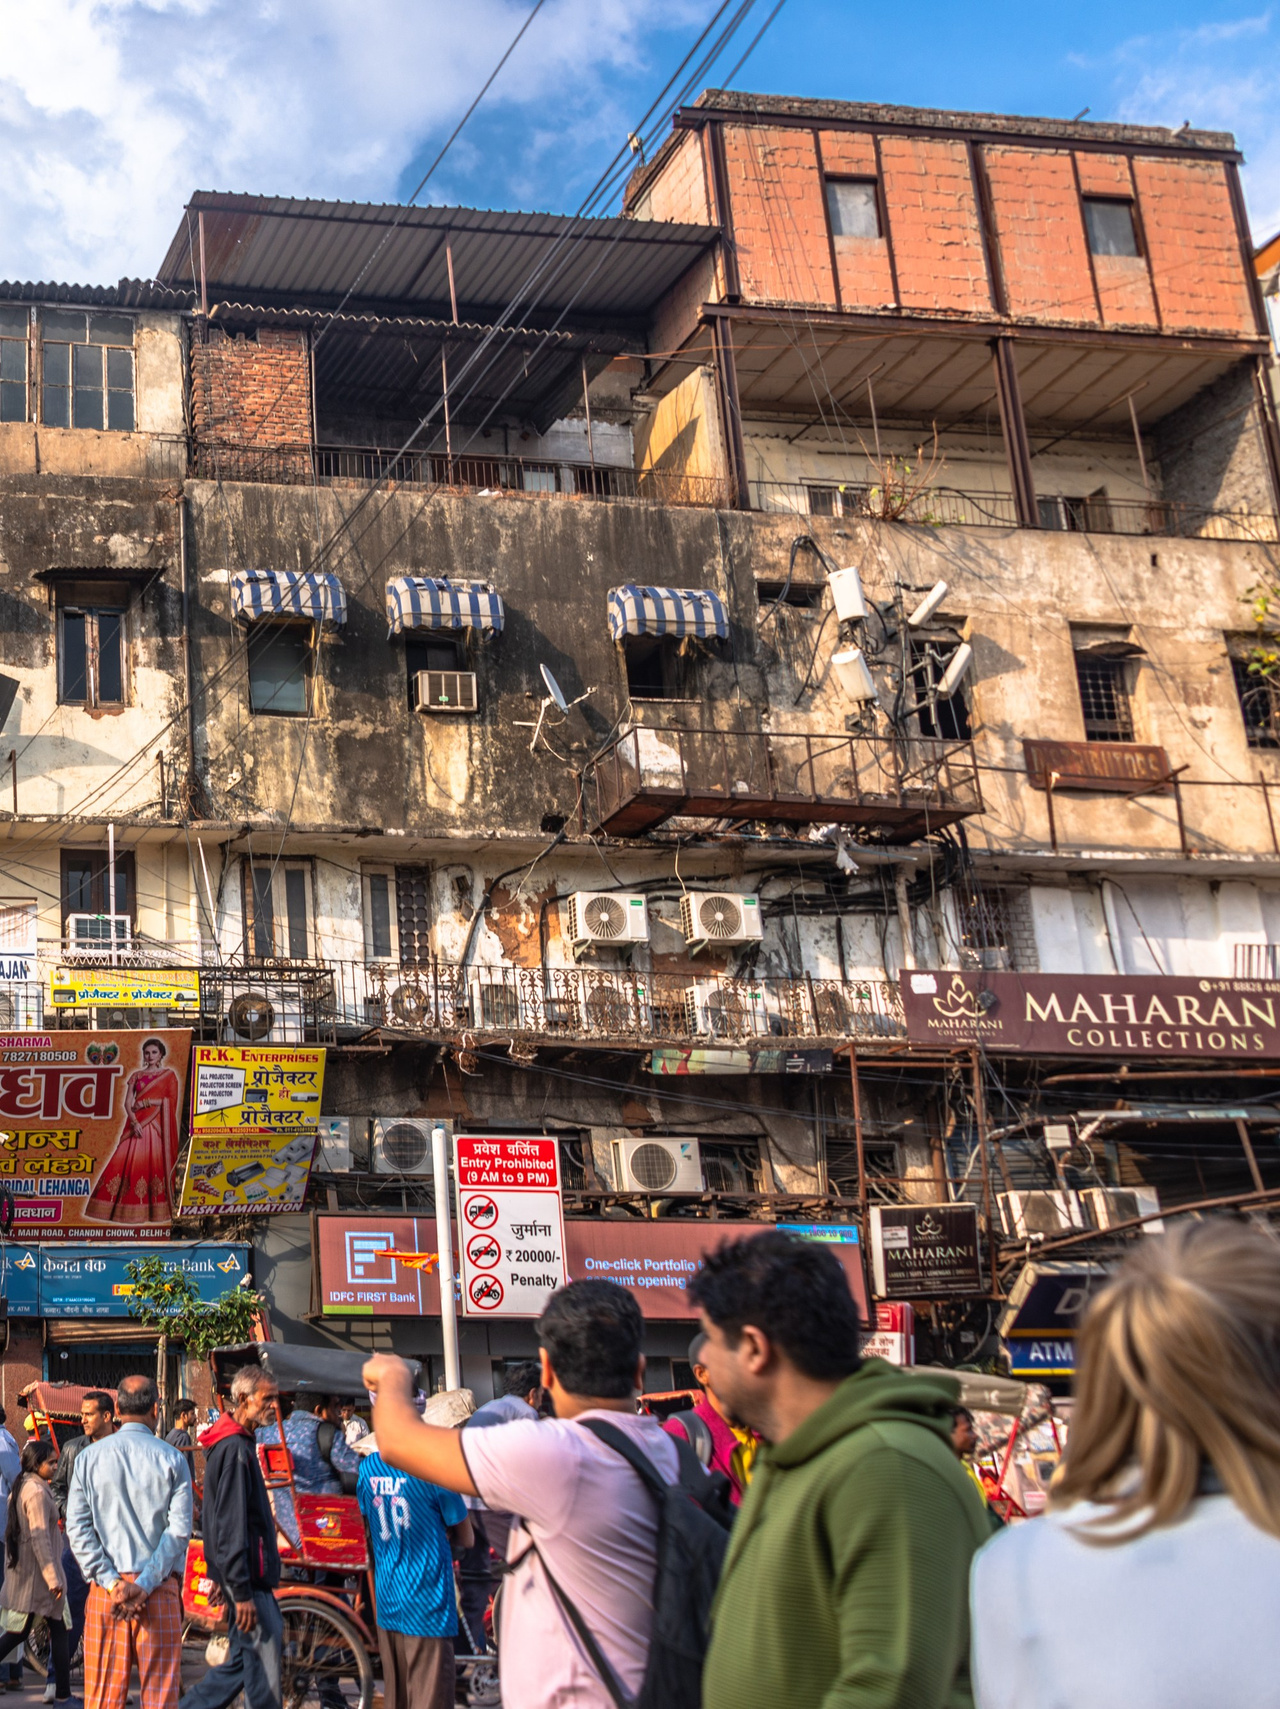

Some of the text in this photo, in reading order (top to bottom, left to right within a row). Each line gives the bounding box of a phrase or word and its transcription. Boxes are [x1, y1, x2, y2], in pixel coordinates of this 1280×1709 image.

[927, 1019, 1003, 1030] MAHARANI
[1068, 1029, 1265, 1051] COLLECTIONS
[3, 1051, 77, 1062] 7827180508
[200, 1049, 319, 1063] R.K. ENTERPRISES
[473, 1140, 540, 1157] प्रवेश वर्जित
[461, 1157, 554, 1171] Entry Prohibited
[466, 1172, 550, 1186] (9 AM to 9 PM)
[39, 1178, 90, 1197] LEHANGA
[182, 1203, 303, 1216] YASH LAMINATION
[17, 1229, 39, 1237] MAIN
[41, 1229, 66, 1238] ROAD,
[68, 1229, 104, 1237] CHANDNI
[106, 1229, 138, 1238] CHOWK,
[140, 1229, 171, 1237] DELHI-6
[510, 1221, 552, 1240] जुर्माना
[515, 1249, 561, 1263] 20000/-
[887, 1246, 974, 1260] MAHARANI
[182, 1258, 215, 1272] Bank
[584, 1257, 696, 1272] One-click Portfolio
[510, 1273, 558, 1290] Penalty
[637, 1276, 687, 1290] opening
[330, 1291, 416, 1303] IDFC FIRST Bank
[1029, 1342, 1074, 1362] ATM
